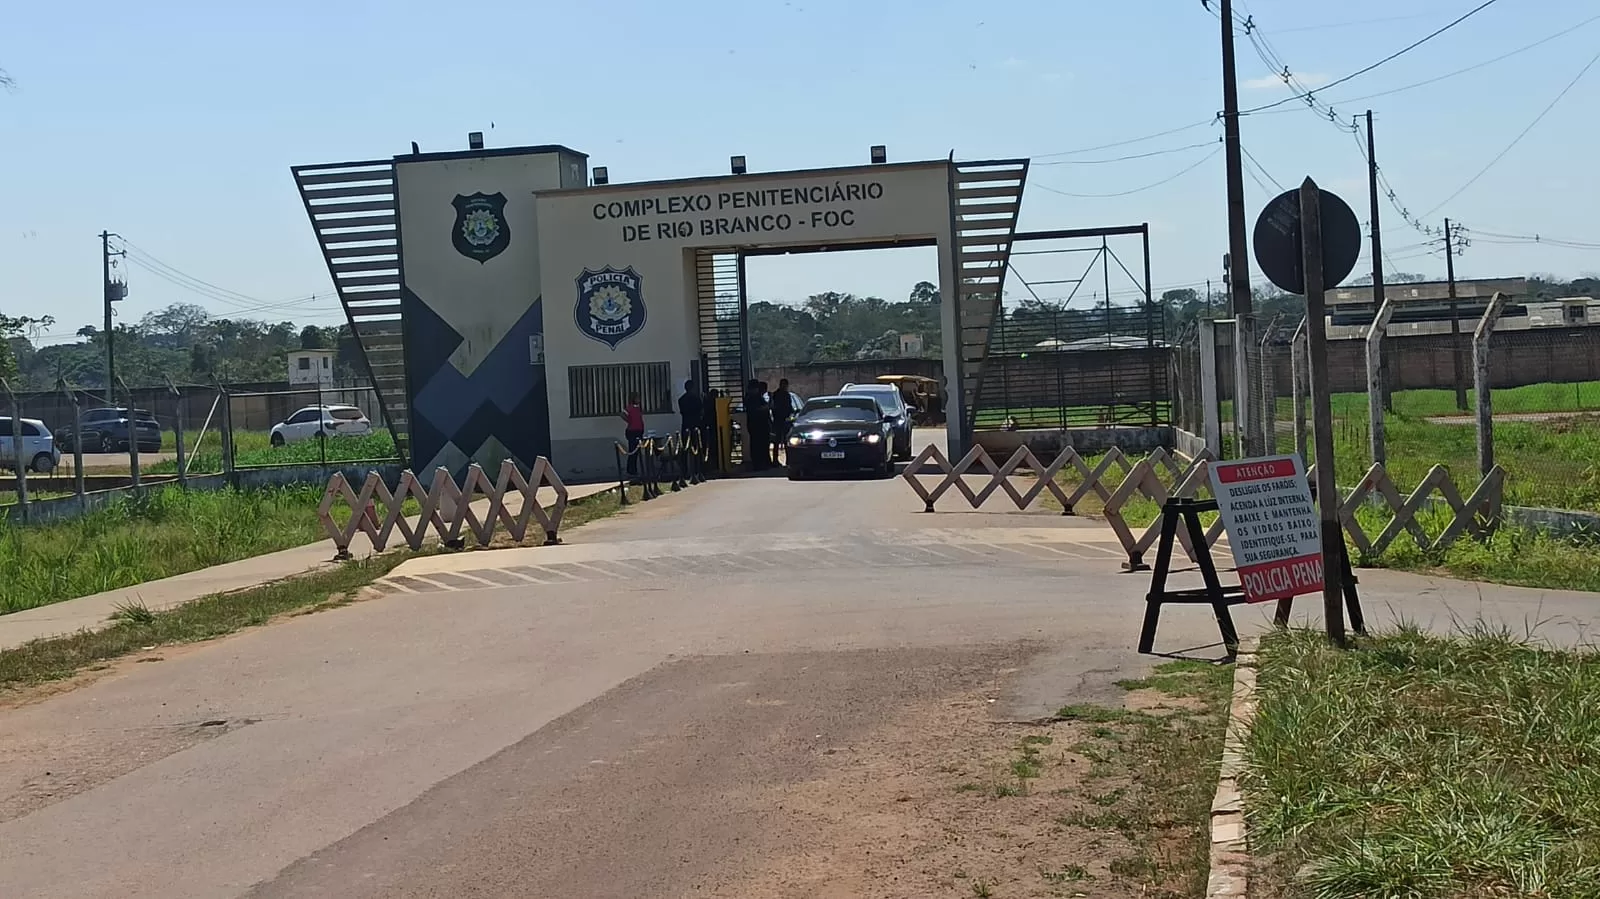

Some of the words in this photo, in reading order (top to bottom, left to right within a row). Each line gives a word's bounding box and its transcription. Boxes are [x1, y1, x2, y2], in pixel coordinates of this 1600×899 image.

[593, 194, 711, 220] COMPLEXO
[718, 181, 883, 210] PENITENCIÁRIO
[622, 225, 650, 242] DE
[657, 221, 693, 239] RIO
[700, 213, 791, 236] BRANCO
[811, 209, 855, 228] FOC
[595, 324, 625, 333] PENAL
[1236, 464, 1275, 479] ATENÇÃO
[1229, 484, 1262, 497] DESLIGUE
[1261, 481, 1272, 492] OS
[1230, 500, 1258, 512] ACENDA
[1258, 497, 1265, 508] A
[1234, 512, 1261, 524] ABAIXE
[1264, 511, 1269, 520] E
[1272, 506, 1312, 518] MANTENHA
[1237, 527, 1249, 537] OS
[1252, 521, 1284, 535] VIDROS
[1300, 530, 1318, 540] PARA
[1244, 551, 1259, 562] SUA
[1243, 566, 1294, 598] POLÍCIA
[1291, 559, 1324, 588] PENA
